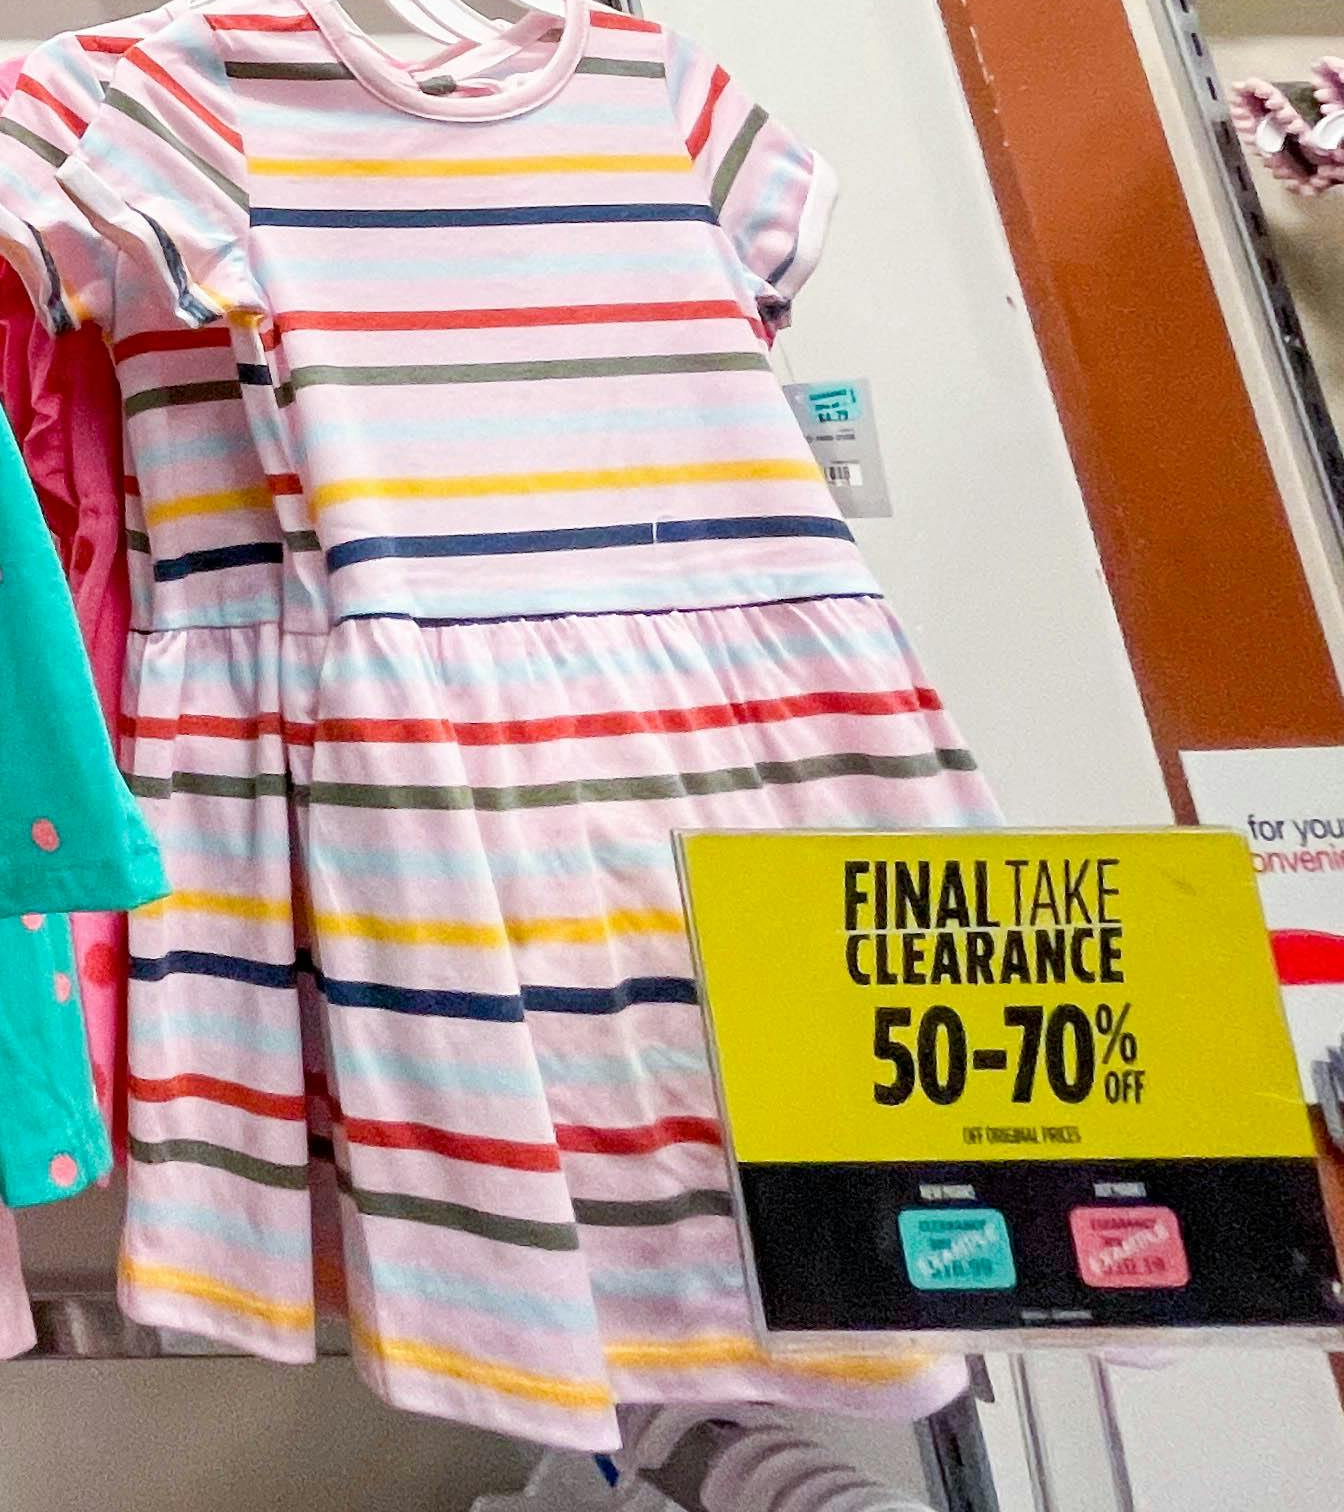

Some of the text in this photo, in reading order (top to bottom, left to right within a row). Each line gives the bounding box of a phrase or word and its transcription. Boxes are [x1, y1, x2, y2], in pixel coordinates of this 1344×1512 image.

[1247, 814, 1285, 842] for
[843, 858, 1121, 931] FINAL TAKE
[845, 928, 1125, 987] CLEARANCE
[1104, 1070, 1146, 1106] OFF
